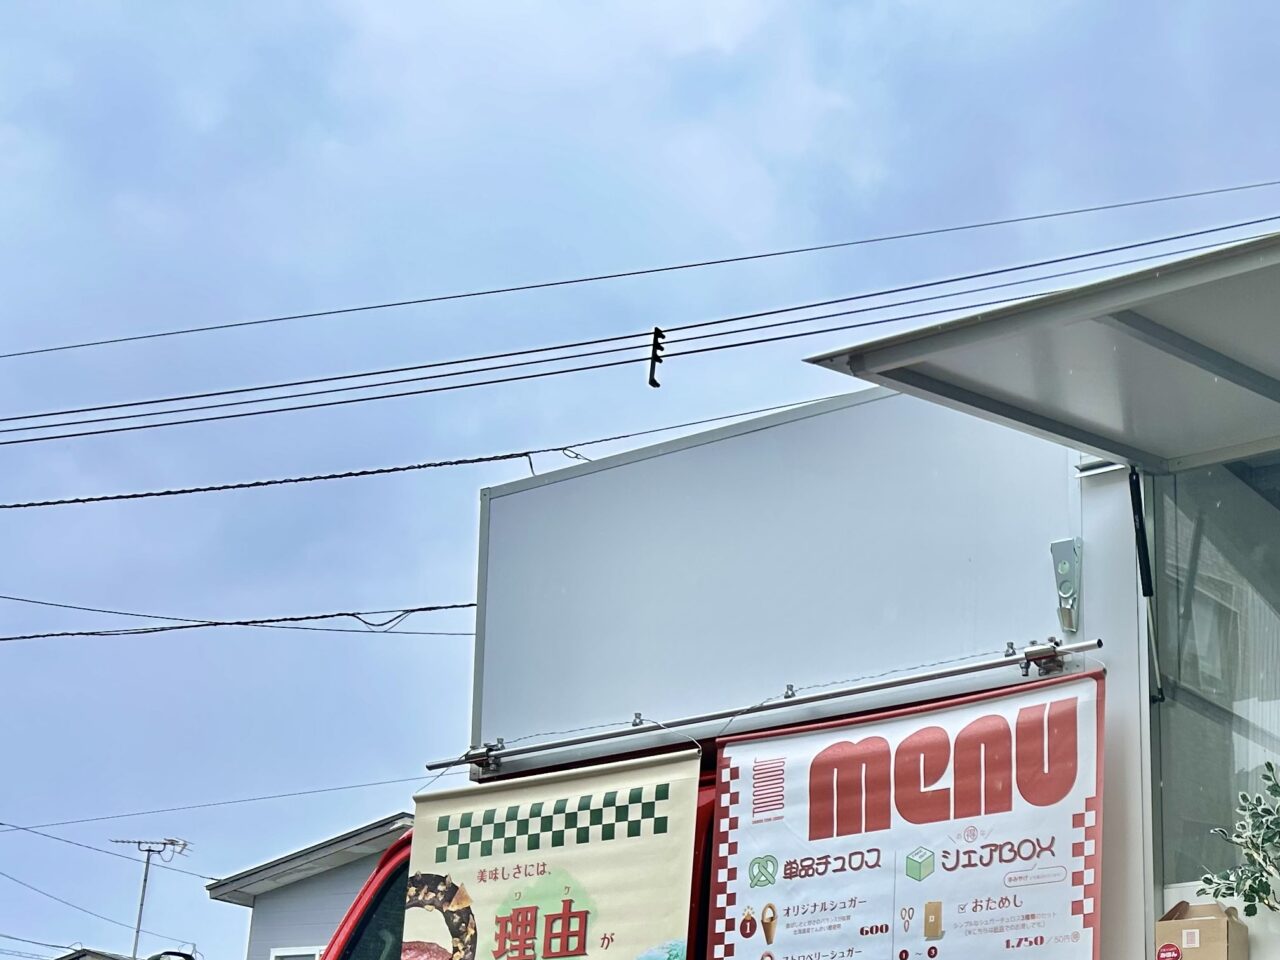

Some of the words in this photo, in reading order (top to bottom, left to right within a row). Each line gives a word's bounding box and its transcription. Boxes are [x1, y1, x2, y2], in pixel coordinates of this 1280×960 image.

[783, 848, 881, 880] 単品チュロス
[783, 896, 867, 918] オリジナルシュガー
[971, 894, 1023, 913] おためし
[859, 923, 890, 936] 600
[600, 932, 615, 950] が
